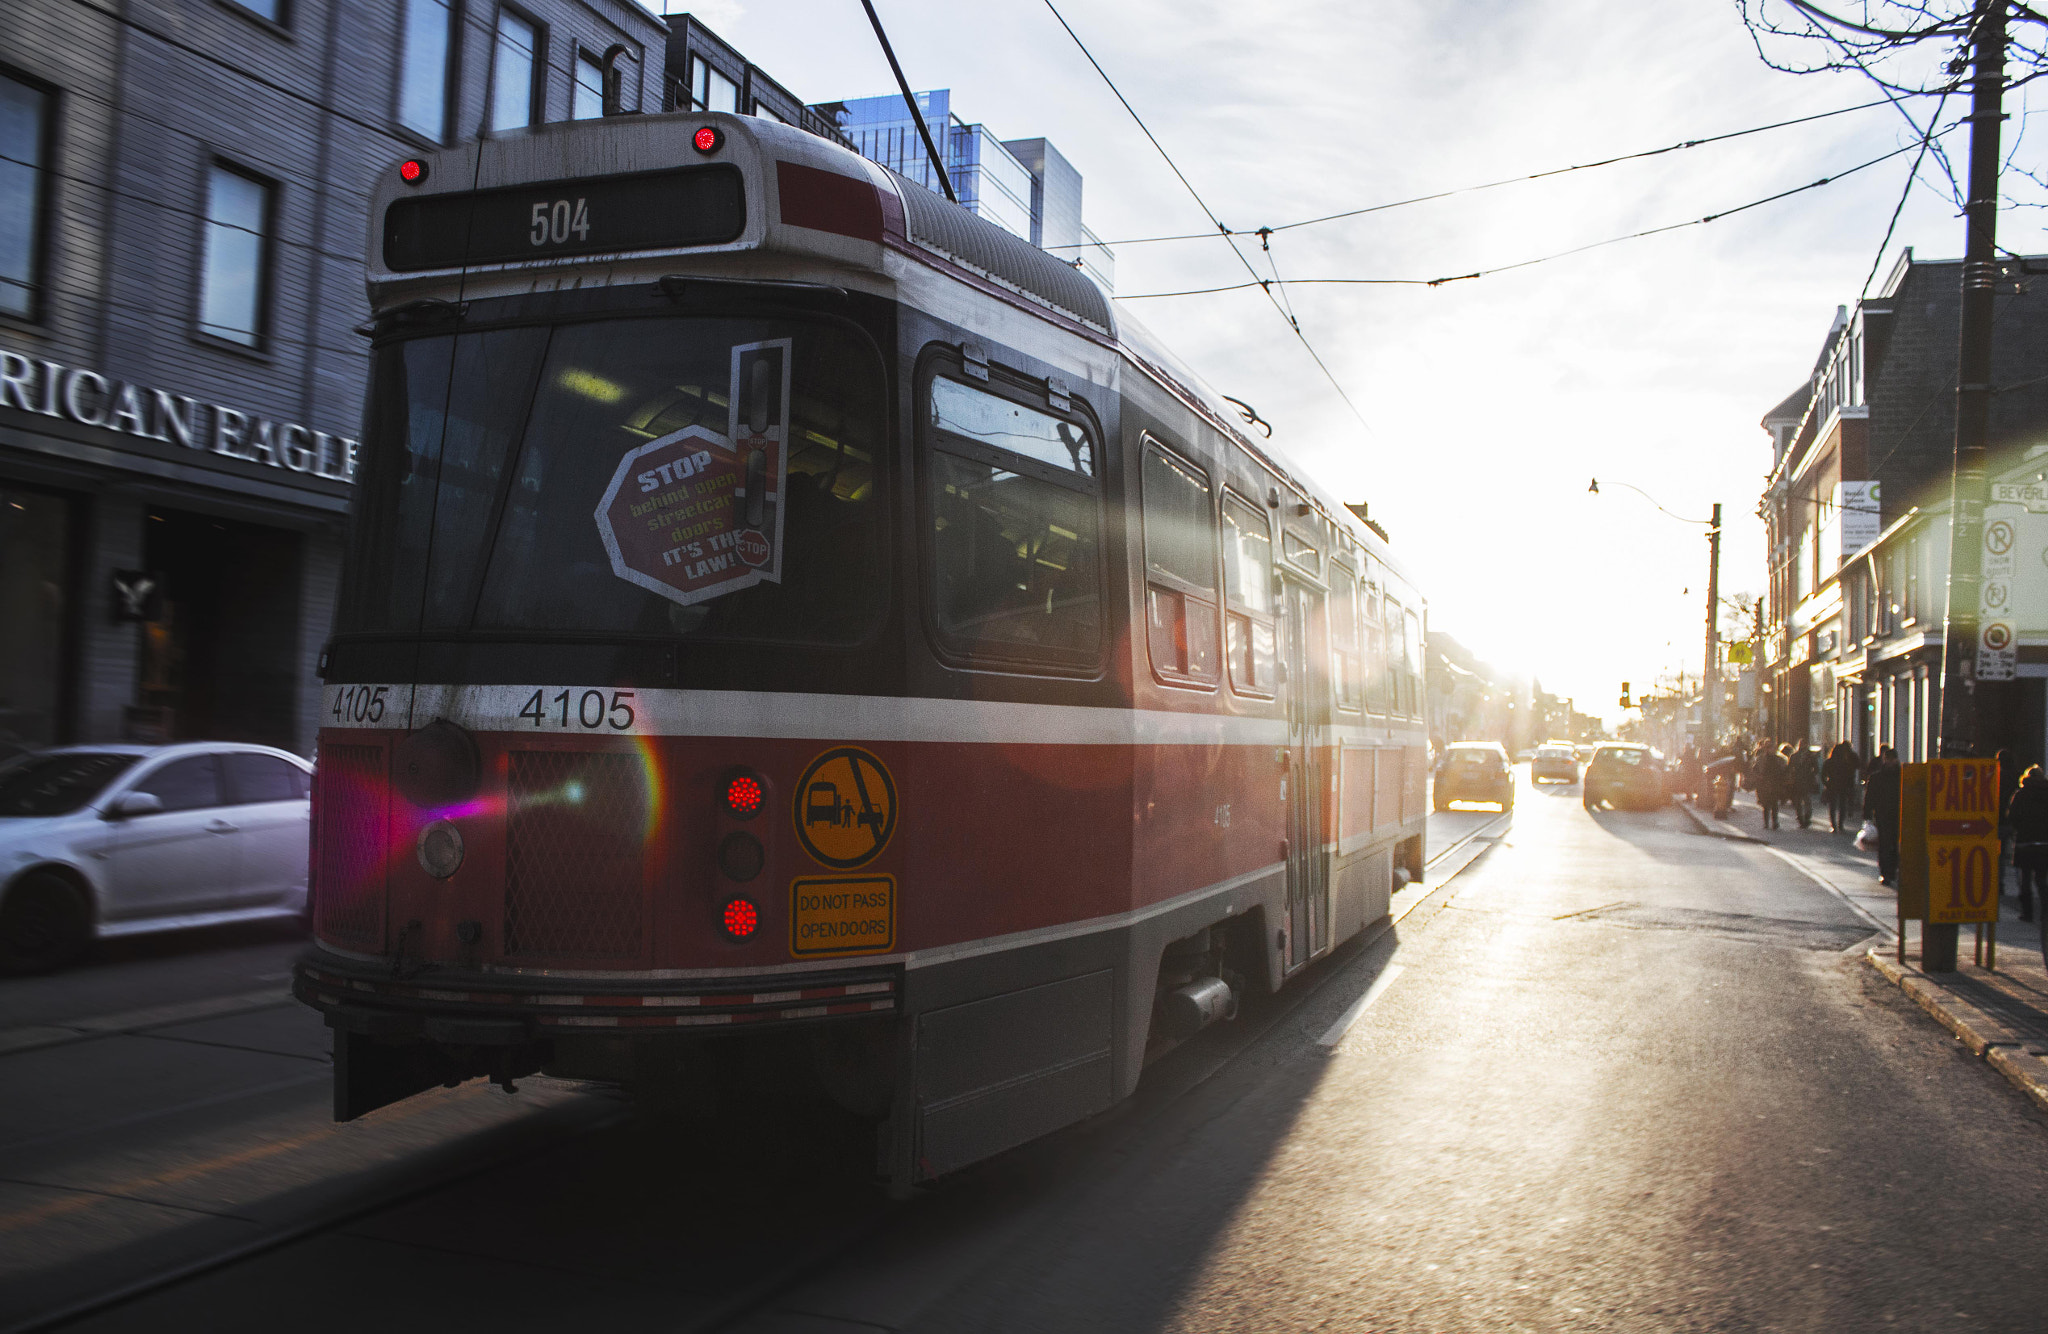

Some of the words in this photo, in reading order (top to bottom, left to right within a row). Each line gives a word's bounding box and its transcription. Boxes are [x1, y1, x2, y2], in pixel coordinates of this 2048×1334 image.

[530, 198, 590, 246] 504
[0, 351, 200, 449] RICAN
[209, 403, 362, 485] EAGLE
[750, 437, 766, 445] STOP
[637, 450, 713, 493] STOP
[630, 485, 690, 517] behind
[694, 472, 737, 495] open
[647, 493, 732, 531] streetcar
[662, 541, 703, 567] IT'S
[706, 529, 745, 551] THE
[671, 517, 724, 542] doors
[684, 552, 736, 580] LAW!
[332, 686, 388, 723] 4105
[518, 689, 635, 731] 4105
[1929, 763, 1995, 812] PARK
[1937, 845, 1992, 908] $10
[800, 895, 820, 911] DO
[822, 894, 850, 910] NOT
[853, 892, 887, 908] PASS
[800, 922, 838, 939] OPEN
[840, 919, 886, 936] DOORS
